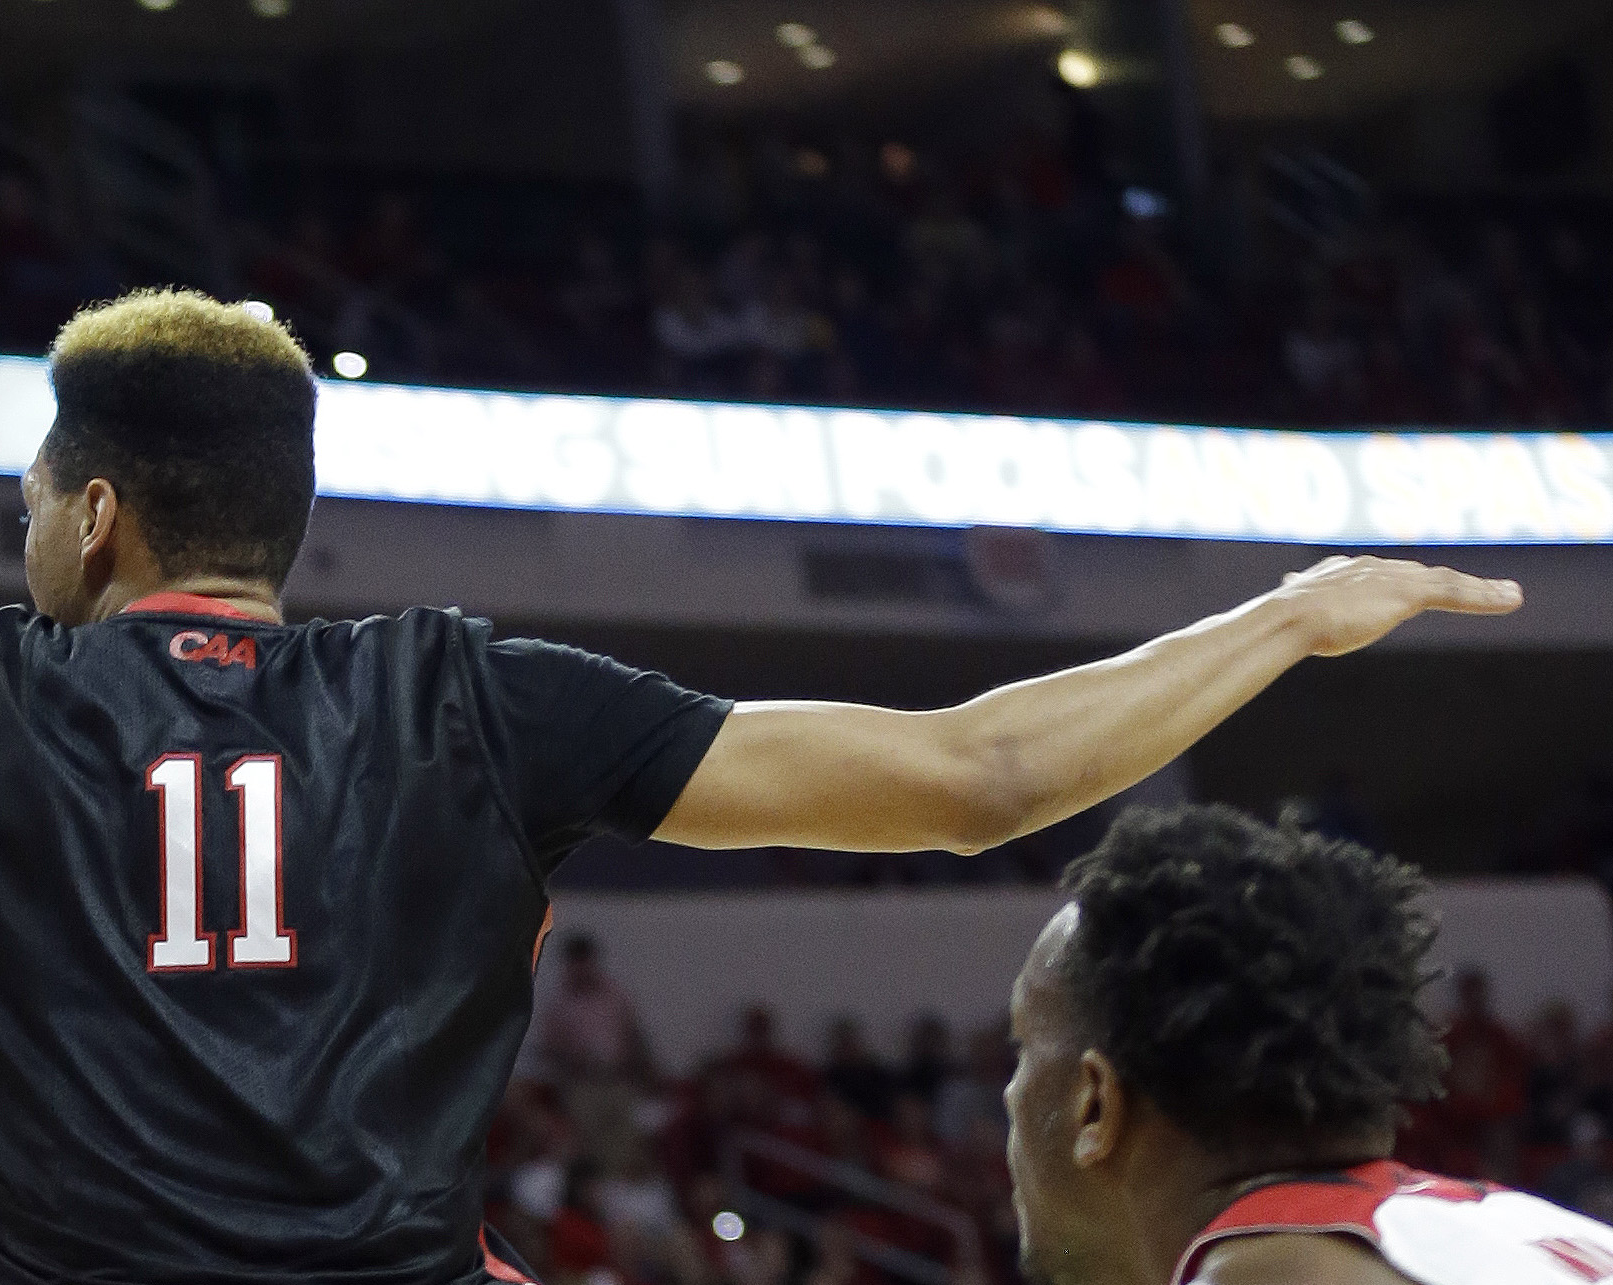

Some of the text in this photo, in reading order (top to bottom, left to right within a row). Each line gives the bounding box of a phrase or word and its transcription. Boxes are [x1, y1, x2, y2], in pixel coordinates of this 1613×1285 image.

[832, 412, 1143, 530] POOLS
[1143, 430, 1352, 538] AND
[1356, 438, 1613, 540] SPAS
[169, 630, 256, 670] CAA
[144, 752, 299, 974] 11
